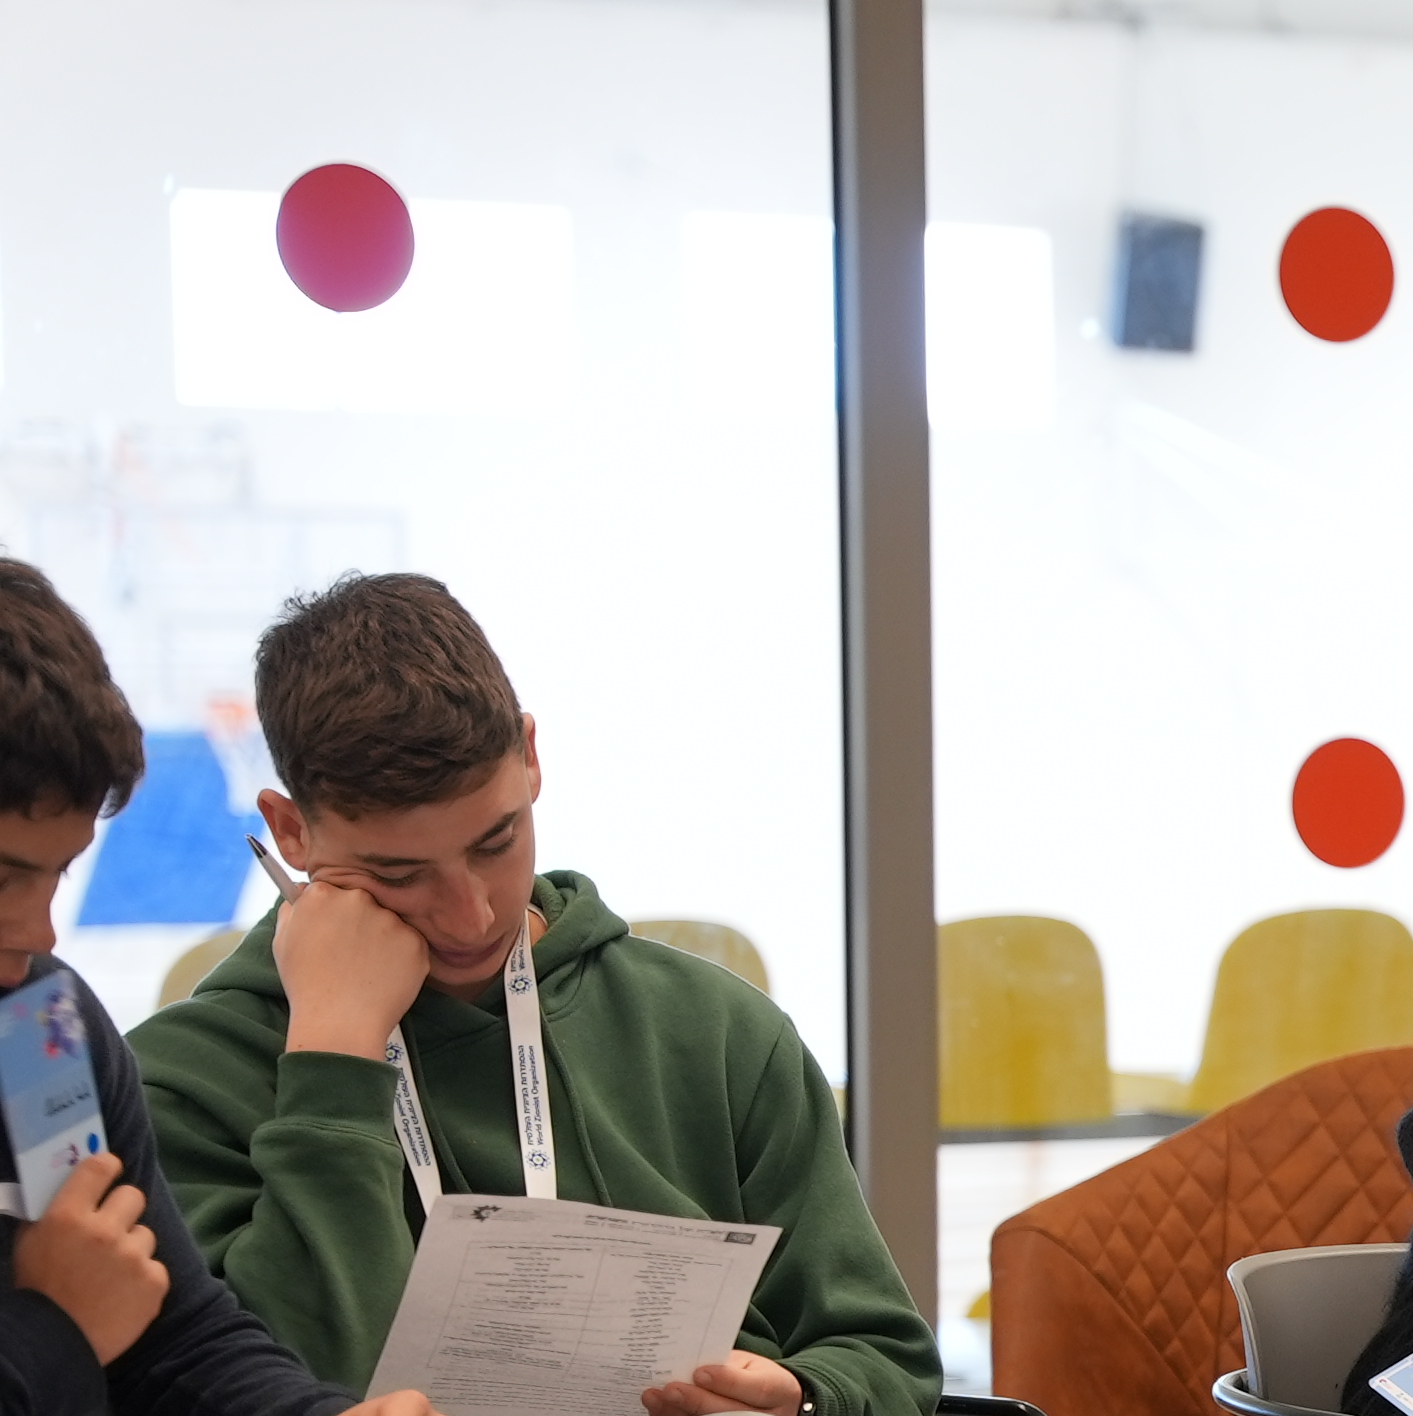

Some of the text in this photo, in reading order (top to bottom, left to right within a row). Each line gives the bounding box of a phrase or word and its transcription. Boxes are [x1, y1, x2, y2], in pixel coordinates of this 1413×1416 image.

[402, 1118, 421, 1166] Organization
[518, 1045, 534, 1146] ההסתדרות הציונית העולמית
[528, 1045, 544, 1146] World Zionist Organization
